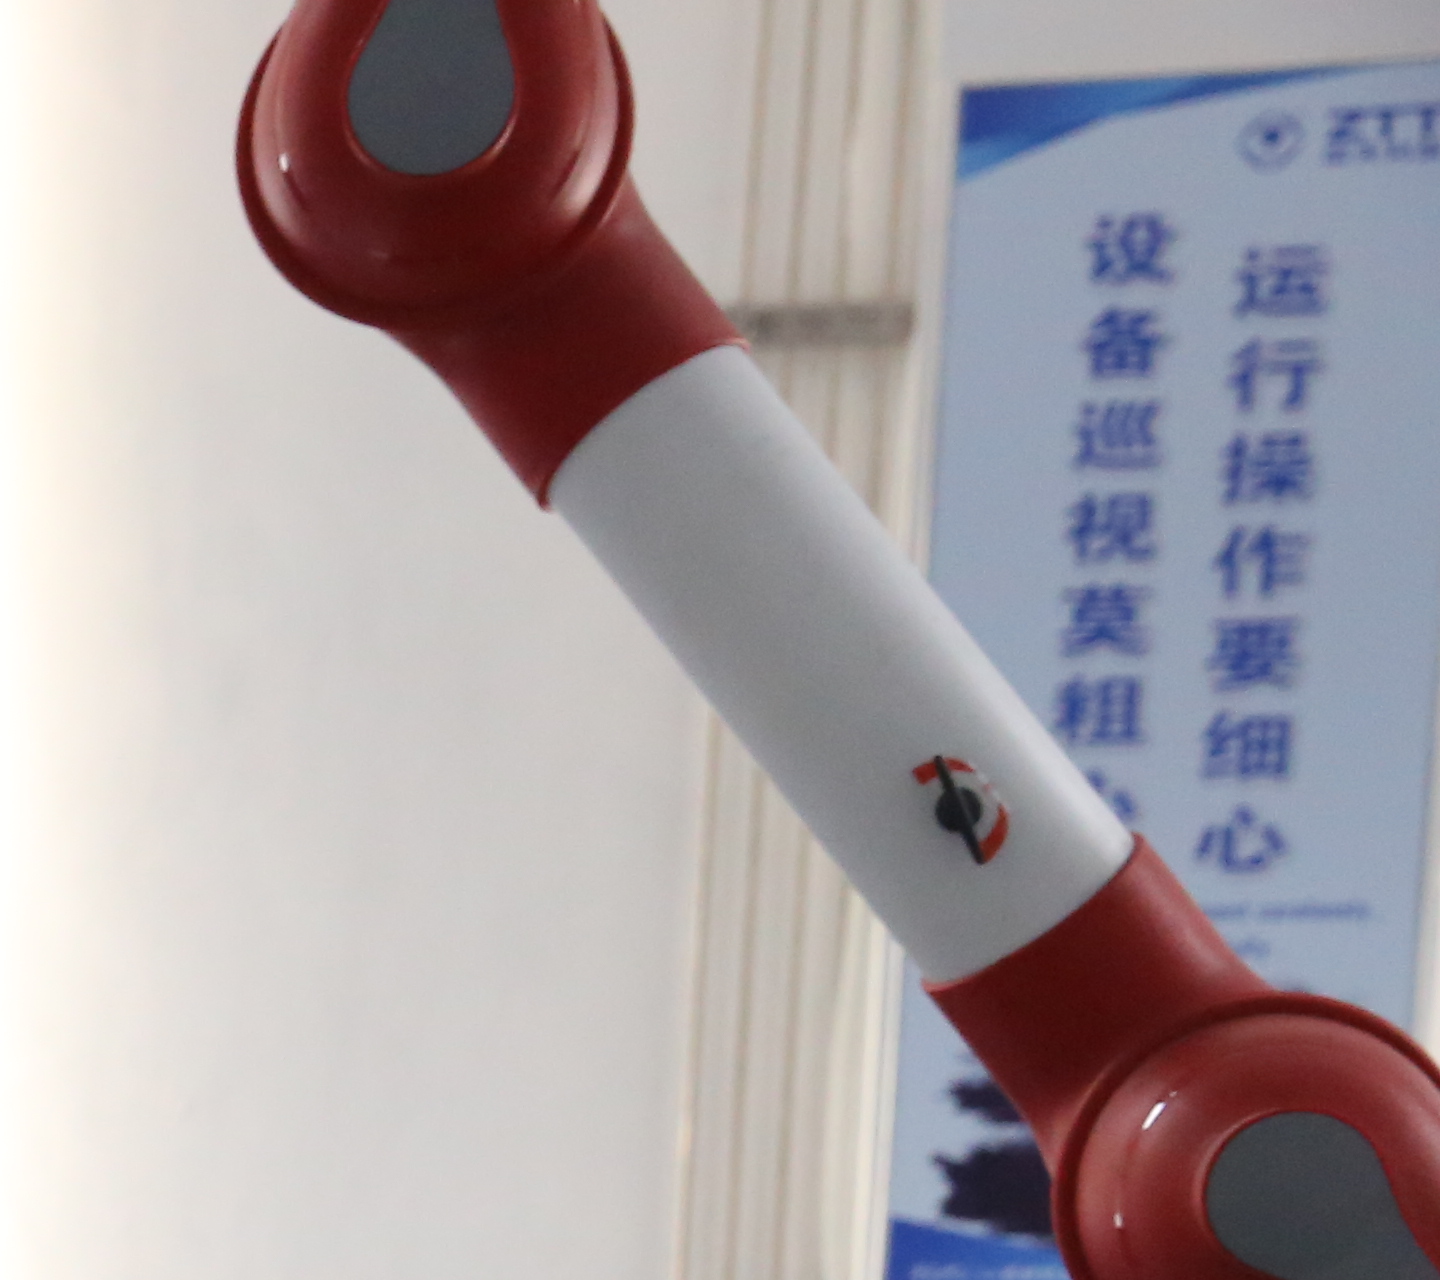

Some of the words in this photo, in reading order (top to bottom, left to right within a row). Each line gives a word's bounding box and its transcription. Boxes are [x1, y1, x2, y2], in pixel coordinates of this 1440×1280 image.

[1196, 243, 1329, 875] 运行操作要细心
